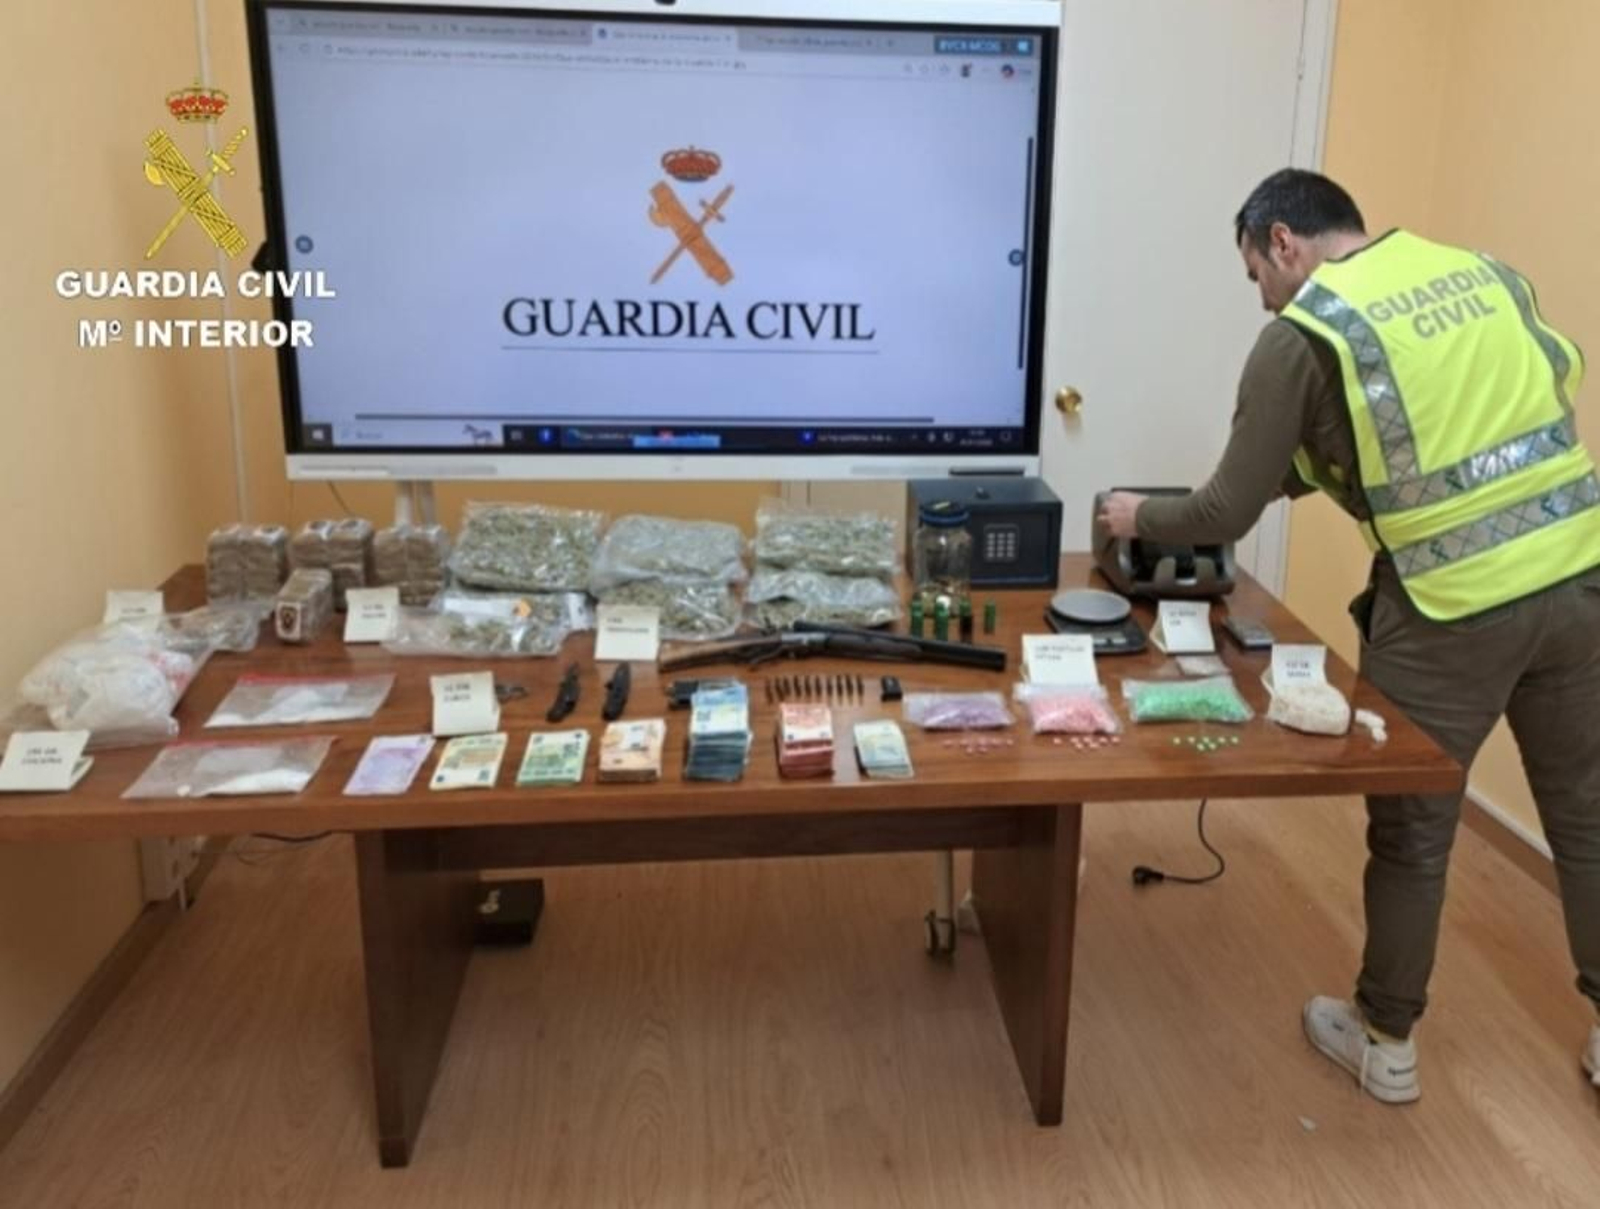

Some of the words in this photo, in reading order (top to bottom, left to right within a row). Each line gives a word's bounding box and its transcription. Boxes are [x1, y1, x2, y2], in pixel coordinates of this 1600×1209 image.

[1366, 265, 1499, 323] GUARDIA
[1412, 293, 1497, 339] CIVIL
[502, 297, 735, 339] GUARDIA
[746, 301, 875, 340] CIVIL
